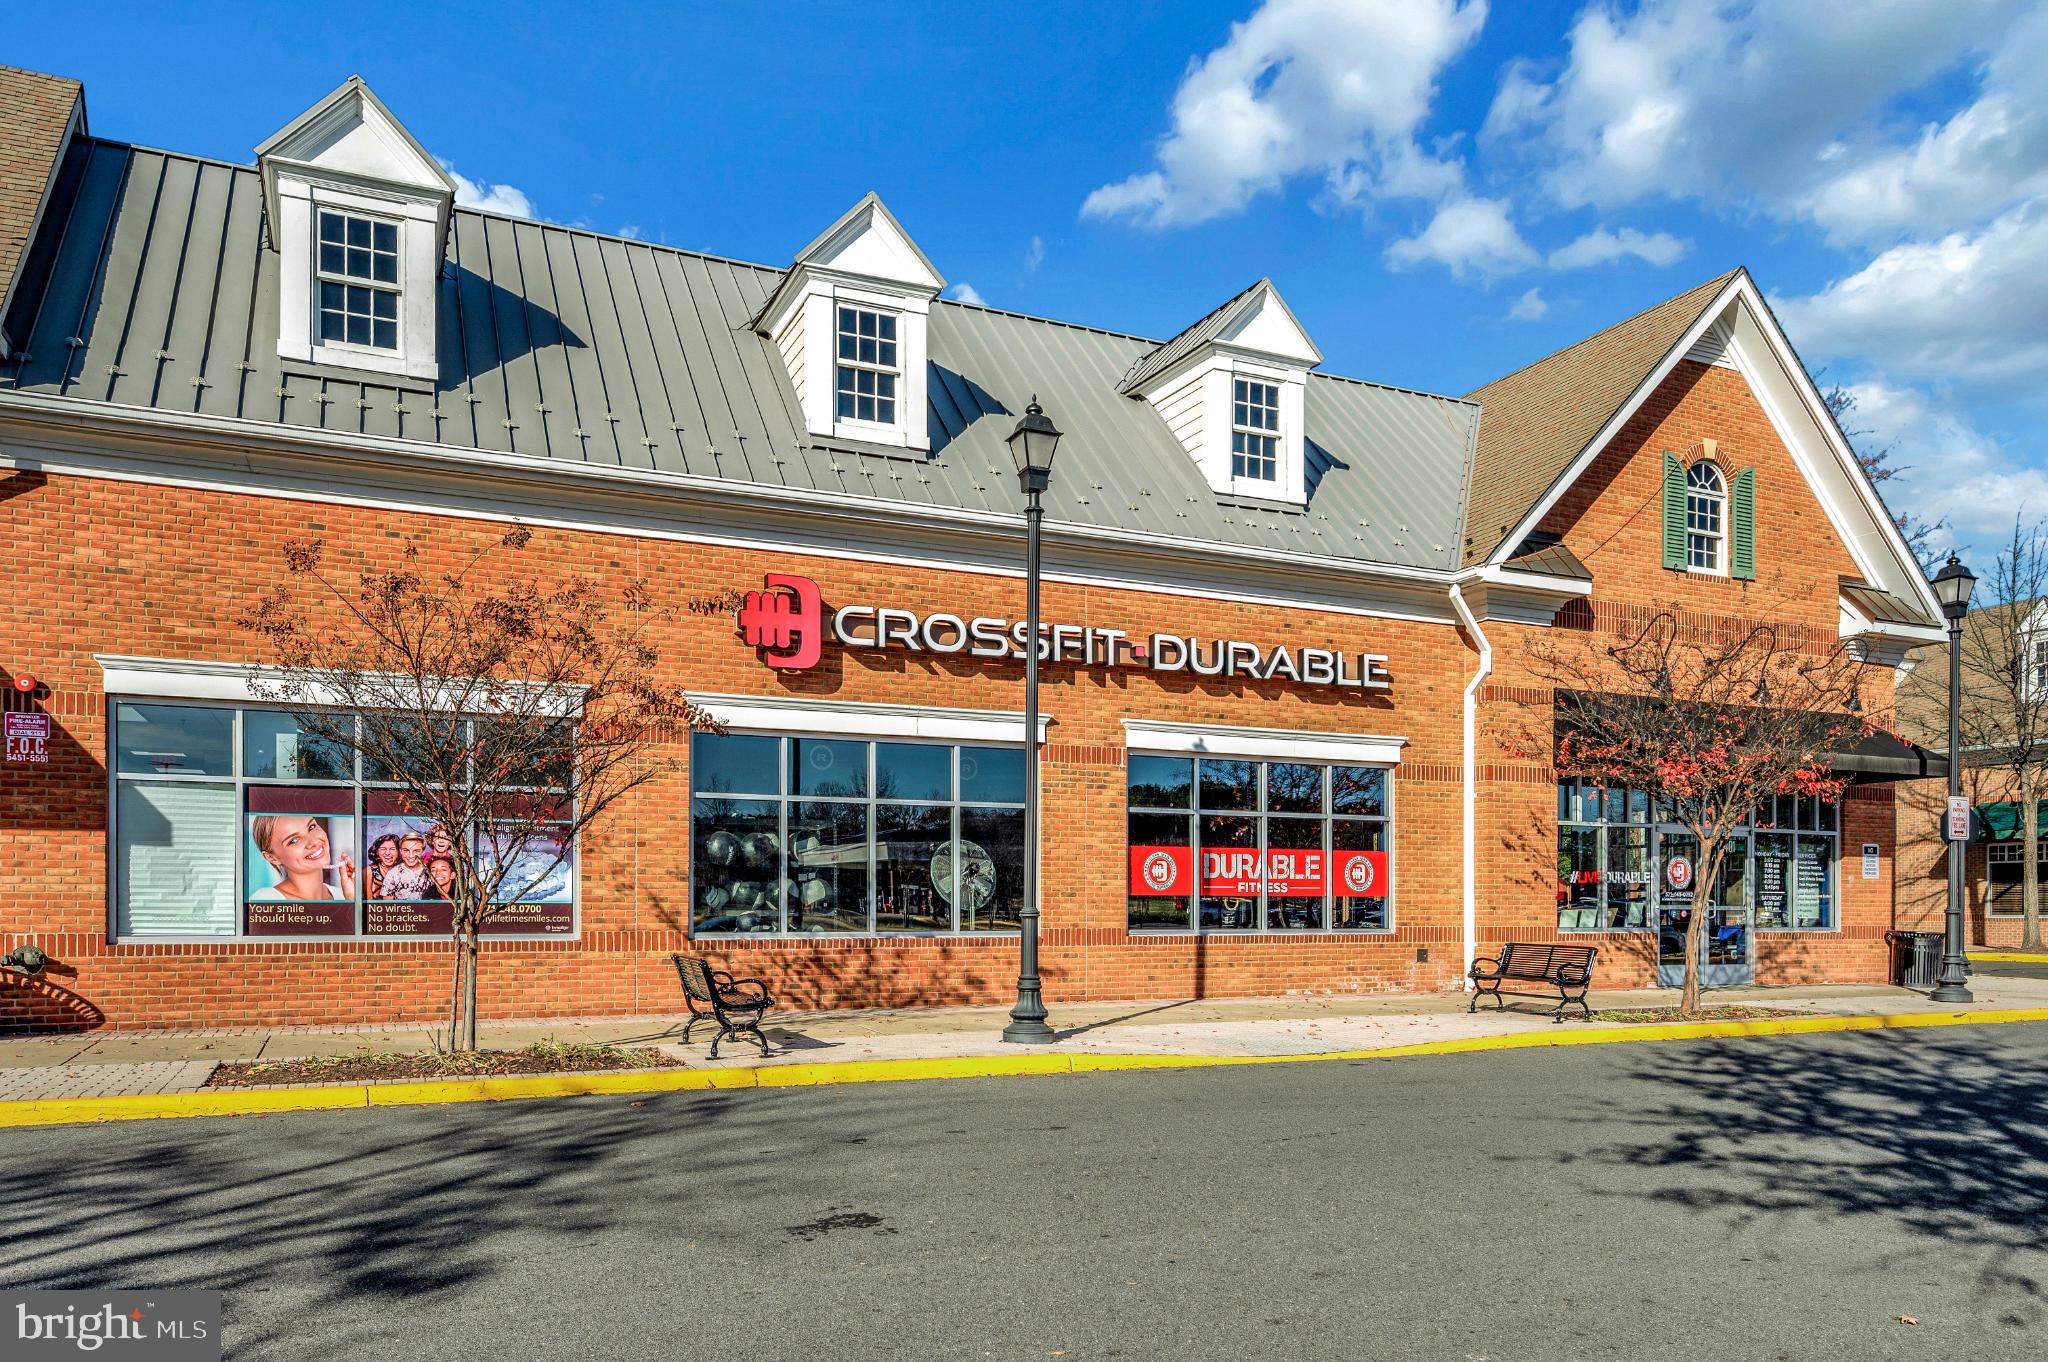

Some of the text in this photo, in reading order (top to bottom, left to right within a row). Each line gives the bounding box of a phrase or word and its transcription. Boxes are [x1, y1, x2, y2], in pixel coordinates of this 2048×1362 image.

[834, 605, 1390, 689] CROSSFIT DURABLE
[7, 737, 49, 755] F.O.C.
[1203, 852, 1321, 880] DURABLE
[1570, 871, 1601, 884] #LIVE
[249, 903, 305, 913] Your smile
[368, 903, 415, 913] No wires.
[486, 904, 542, 914] 7148.0700
[249, 913, 332, 925] should keep up.
[368, 913, 430, 923] No brackets.
[368, 922, 418, 932] No doubt.
